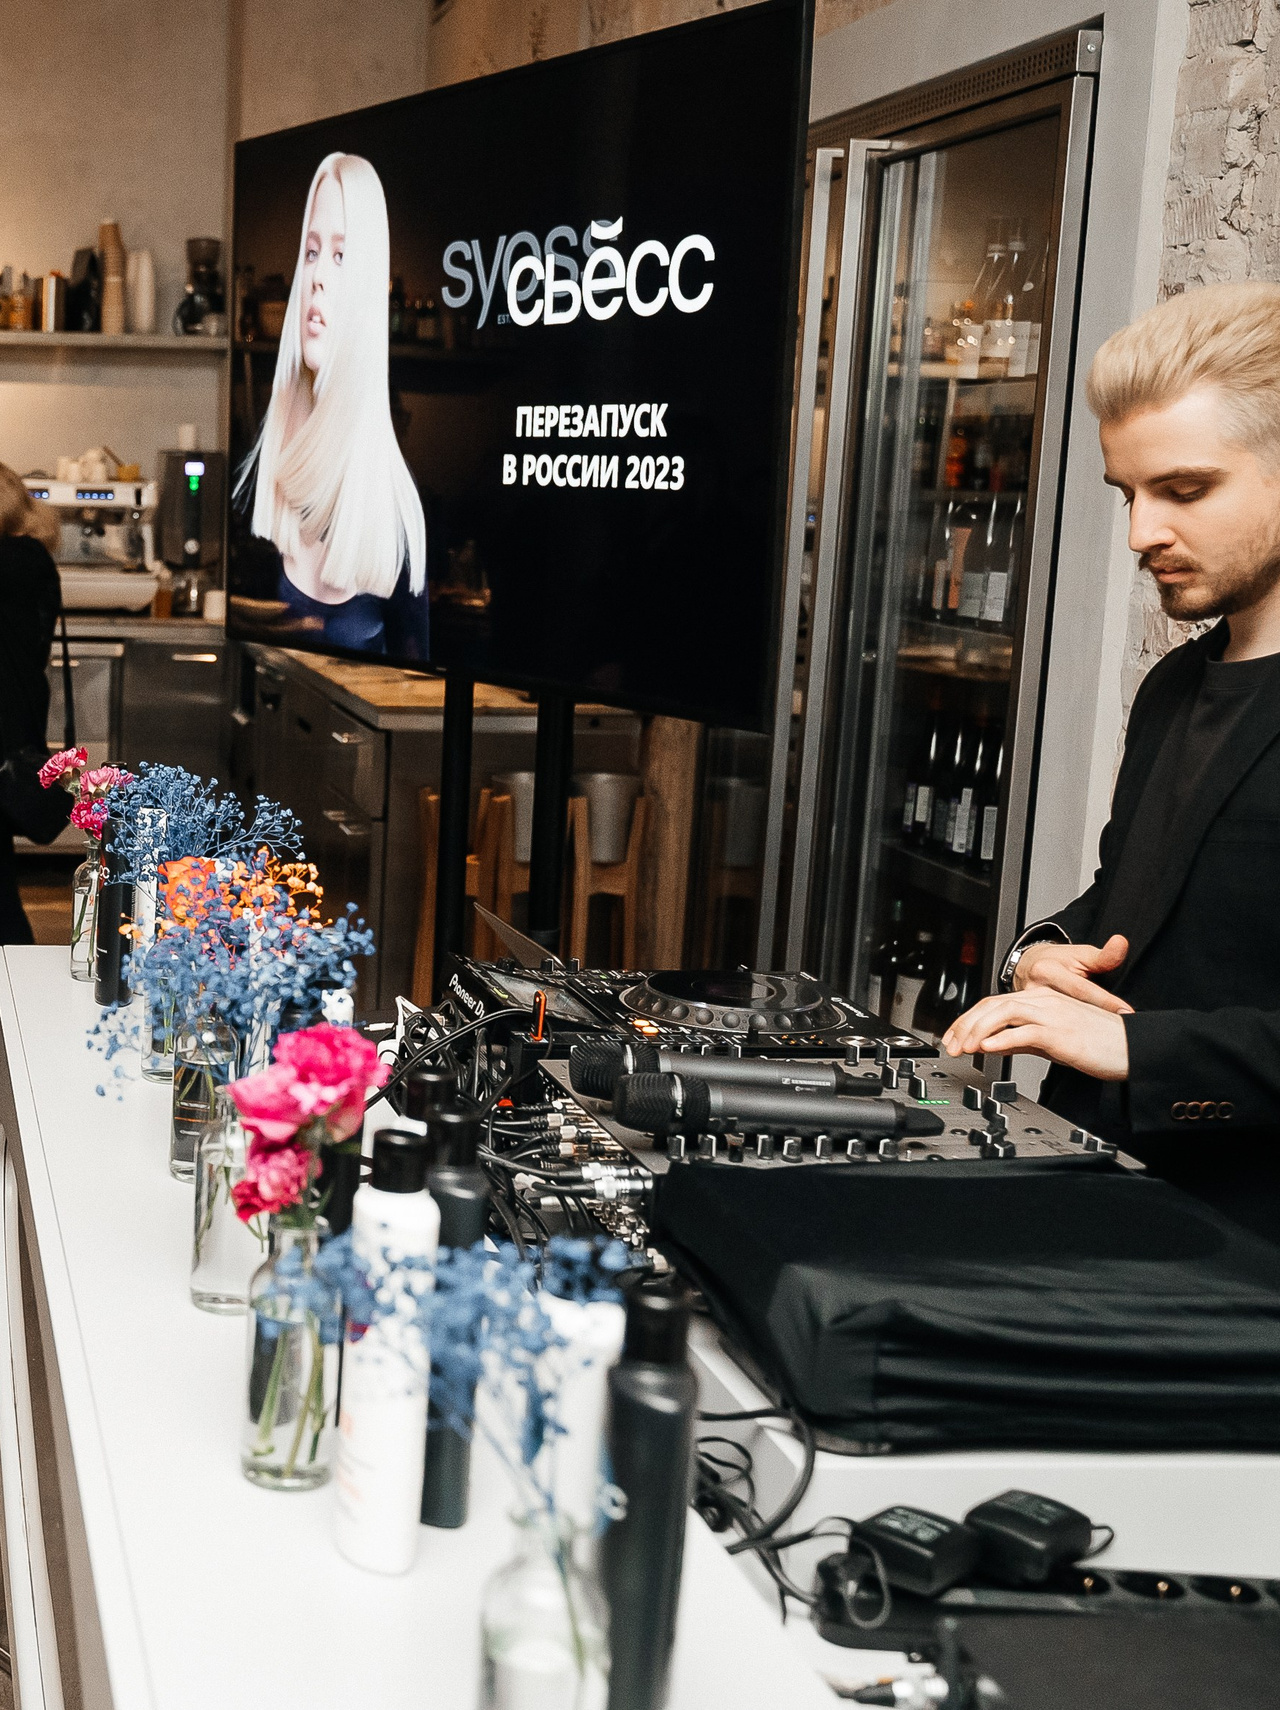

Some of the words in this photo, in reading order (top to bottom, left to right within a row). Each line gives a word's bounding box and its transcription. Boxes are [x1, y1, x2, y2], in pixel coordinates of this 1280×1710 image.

[516, 403, 668, 437] ПЕРЕЗАПУСК
[502, 453, 517, 485] В
[522, 453, 619, 488] РОССИИ
[625, 455, 685, 490] 2023
[449, 973, 477, 1010] Pioneer
